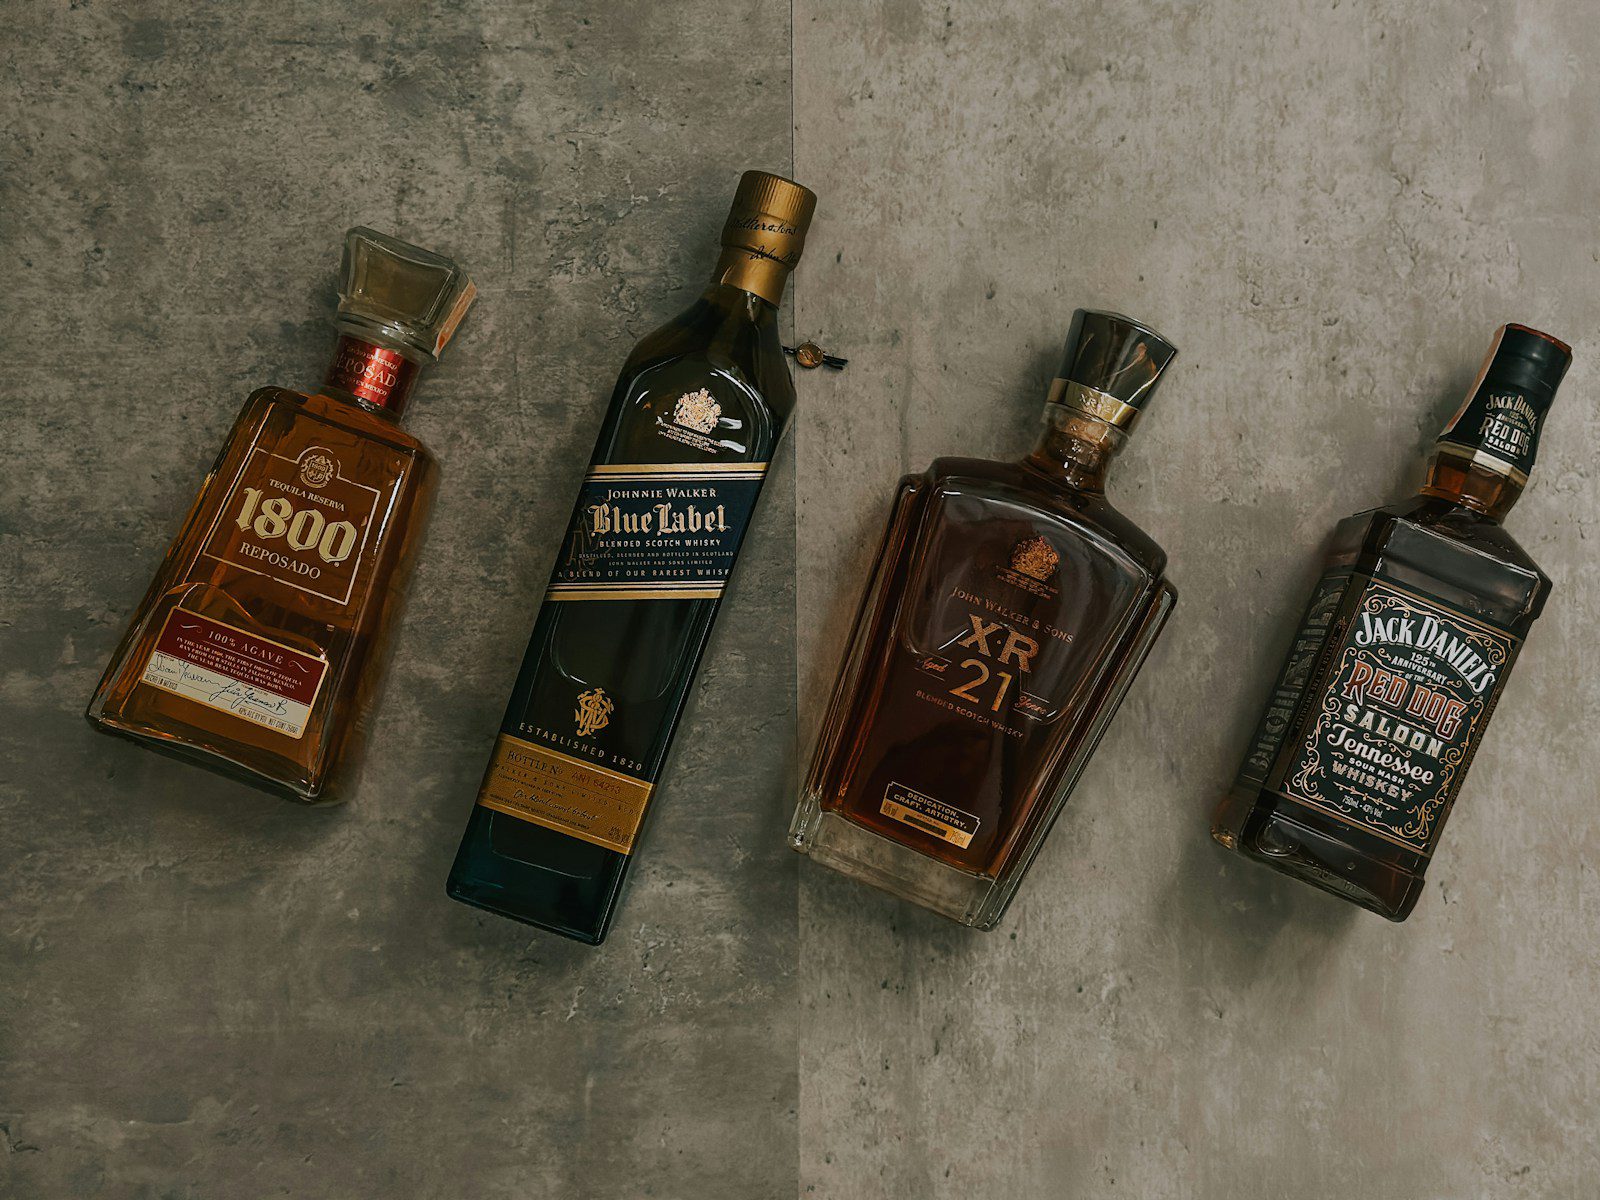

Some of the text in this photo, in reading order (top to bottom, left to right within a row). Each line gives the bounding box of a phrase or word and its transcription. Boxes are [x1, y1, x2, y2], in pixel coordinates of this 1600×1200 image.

[1486, 394, 1515, 410] JACK
[1479, 416, 1530, 456] RED DOG
[1488, 436, 1521, 454] SALOON
[267, 478, 346, 511] TEQUILA RESERVA
[607, 487, 716, 500] JOHNNIE WALKER
[235, 487, 357, 563] 1800
[587, 502, 728, 536] Blue Label
[239, 542, 321, 579] REPOSADO
[599, 538, 720, 548] BLENDED SCOTCH WHISKY
[952, 586, 1074, 643] JOHN WALKER & SONS
[207, 630, 284, 664] 100% AGAVE
[1355, 612, 1496, 694] JACK DANIEL'S
[949, 659, 1012, 712] 21
[1391, 656, 1448, 686] ANNIVERSARY
[915, 689, 1023, 738] BLENDED SCOTCH WHISKY
[1341, 659, 1469, 741] RED DOG
[518, 722, 642, 771] ESTABLISHED 1820
[1344, 703, 1445, 759] SALOON
[506, 750, 547, 771] BOTTLE
[1326, 723, 1435, 785] Tennessee
[1348, 757, 1405, 786] SOUR MASH
[1331, 760, 1415, 802] WHISKEY
[893, 793, 923, 810] CRAFT.
[924, 807, 967, 828] ARTISTRY.
[906, 792, 959, 818] DEDICATION.
